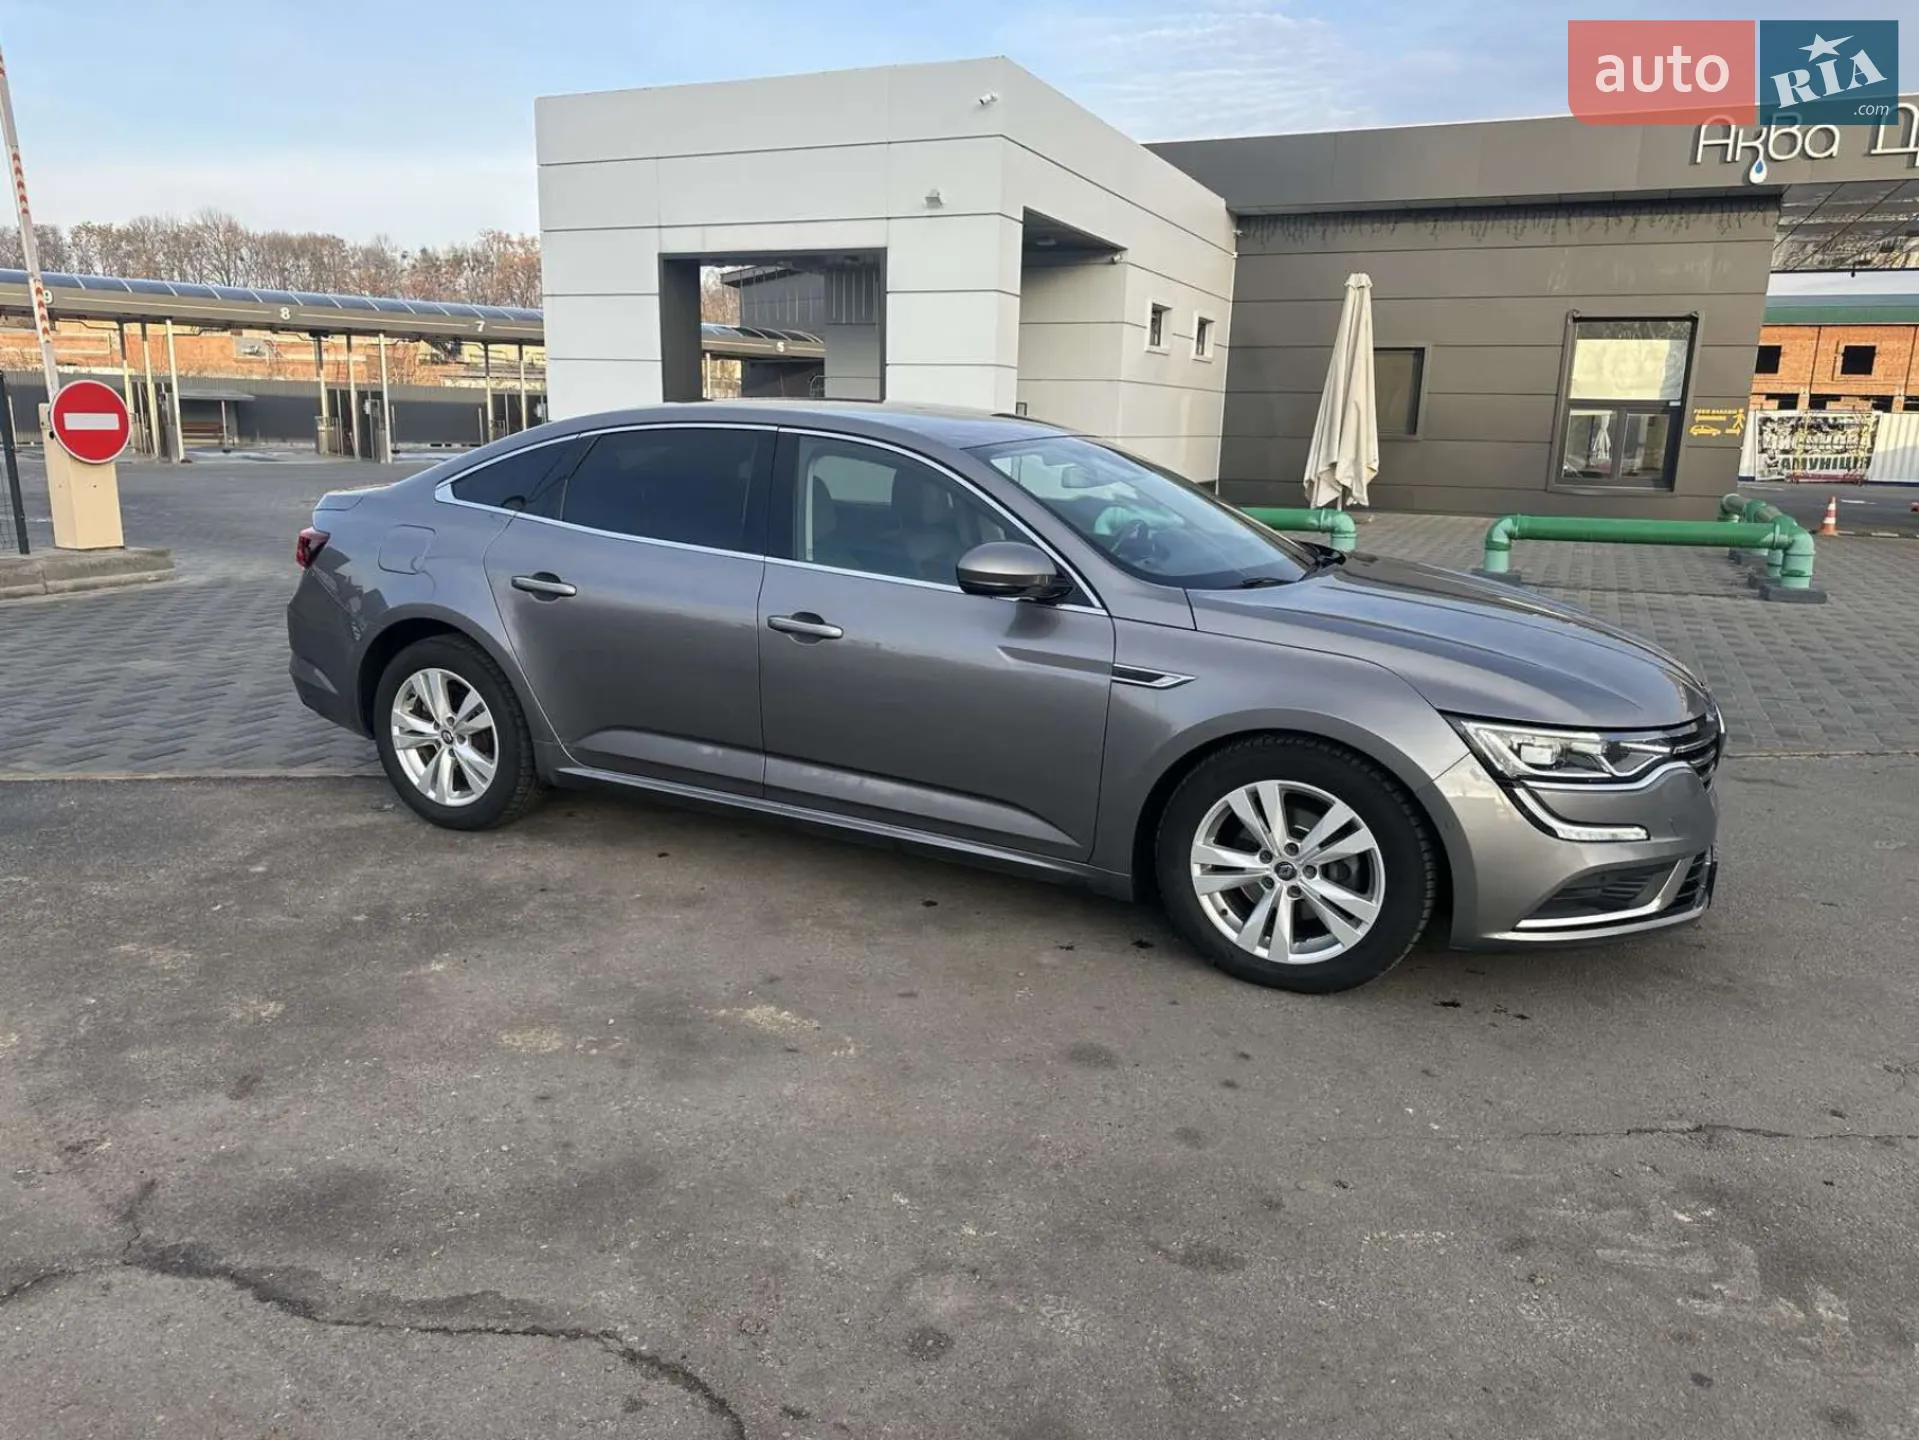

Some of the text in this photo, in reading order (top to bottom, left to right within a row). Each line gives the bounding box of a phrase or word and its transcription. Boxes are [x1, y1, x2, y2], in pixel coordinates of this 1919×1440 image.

[43, 289, 53, 304] 9
[280, 307, 291, 320] 8
[475, 321, 486, 332] 7
